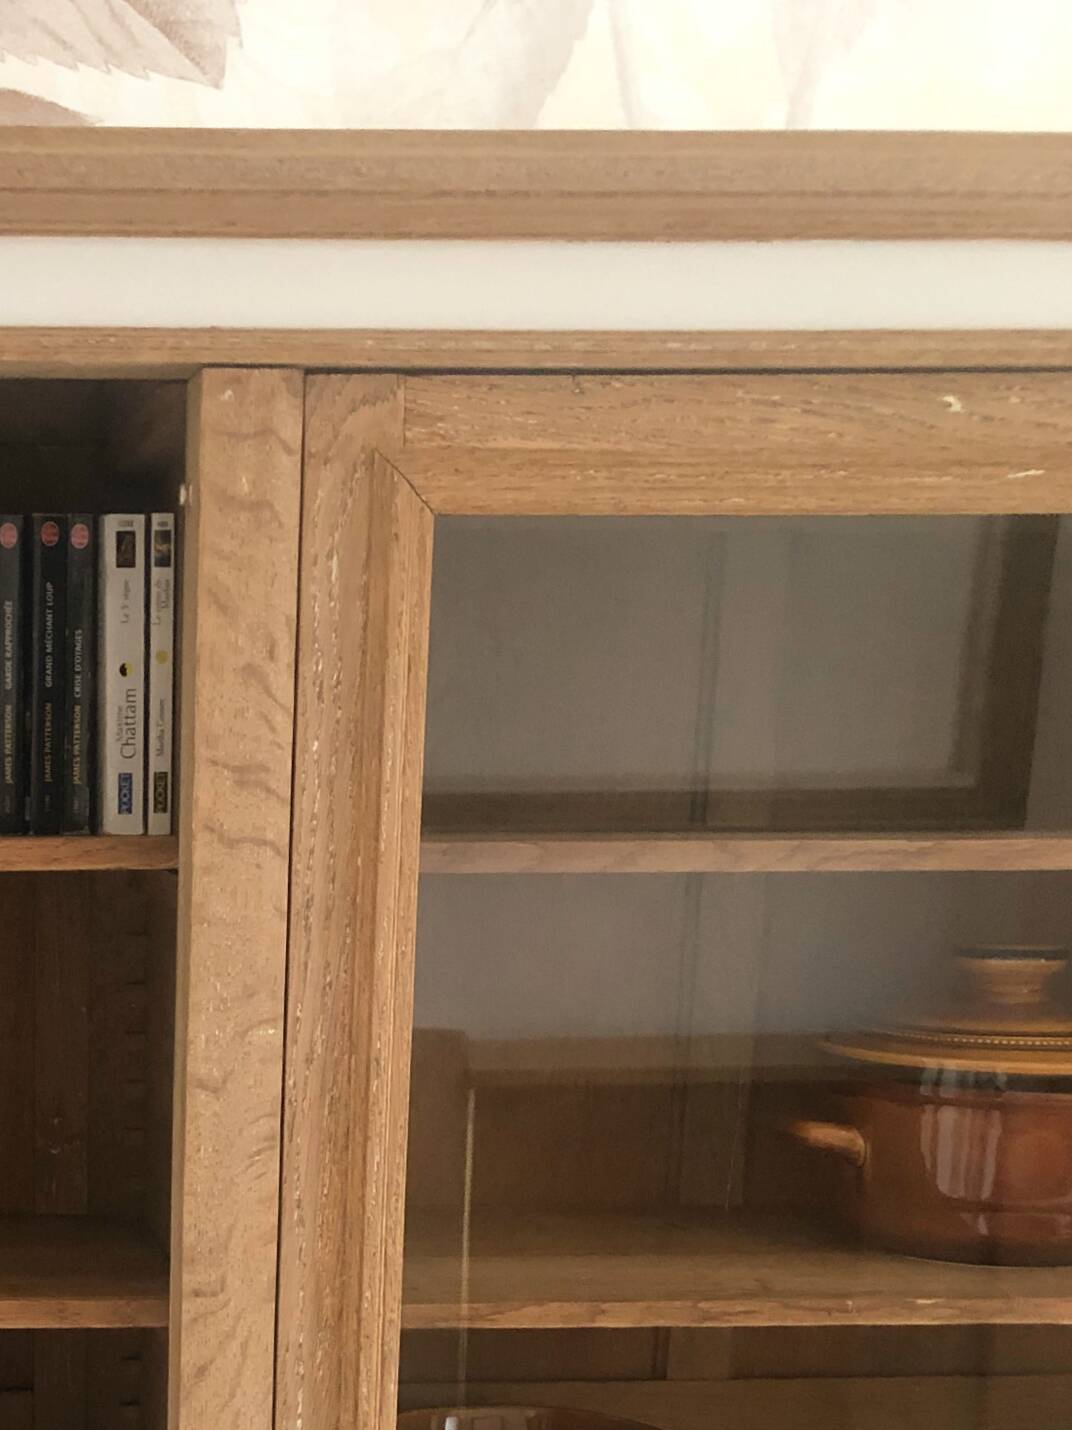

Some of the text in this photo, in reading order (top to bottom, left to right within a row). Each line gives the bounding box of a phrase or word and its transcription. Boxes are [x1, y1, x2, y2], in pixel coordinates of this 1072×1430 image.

[45, 609, 53, 653] MÉCHANT
[2, 660, 11, 690] GARDE
[44, 656, 53, 688] GRAND
[74, 630, 82, 698] CRISE D'OTAGES
[4, 705, 13, 784] JAMES PATTERSON
[44, 703, 52, 782] JAMES PATTERSON
[73, 705, 81, 784] JAMES PATTERSON
[120, 688, 137, 759] Chattam
[119, 774, 131, 814] POCKET
[155, 772, 167, 813] POCKET
